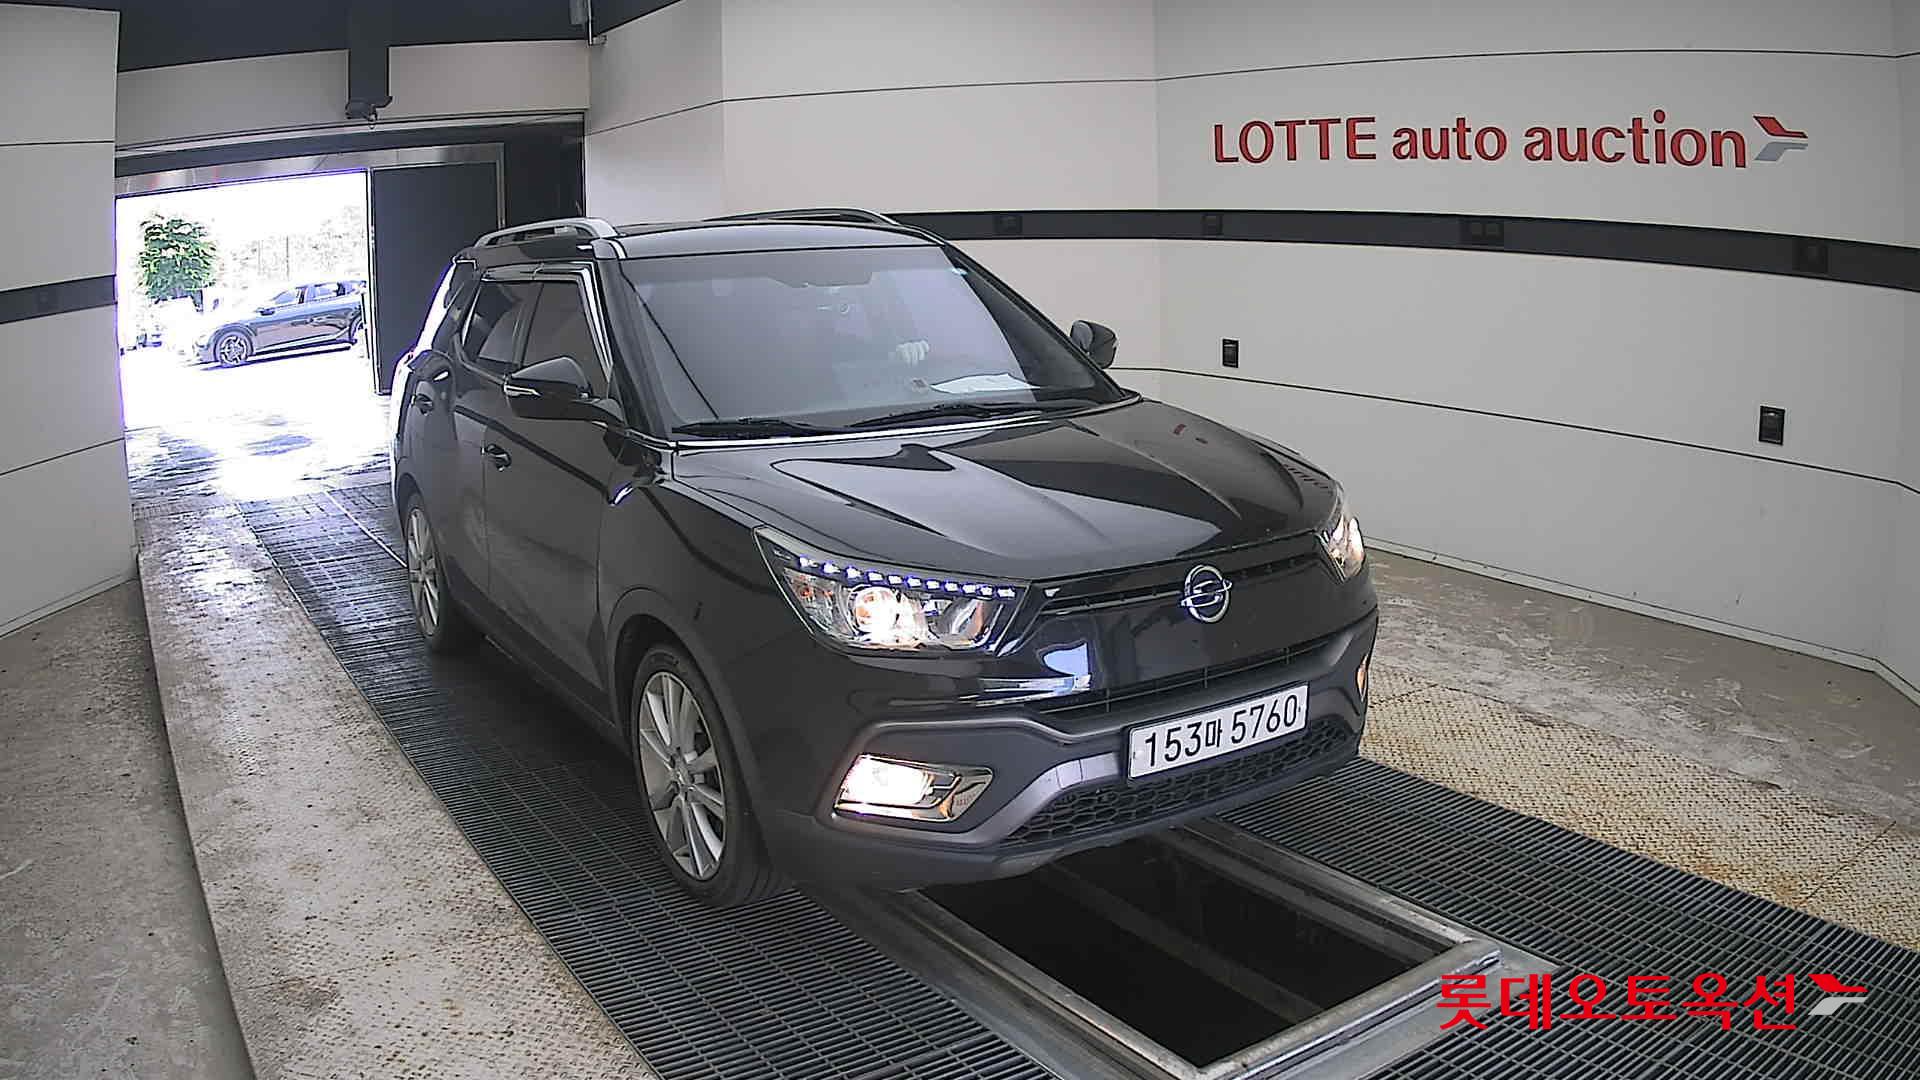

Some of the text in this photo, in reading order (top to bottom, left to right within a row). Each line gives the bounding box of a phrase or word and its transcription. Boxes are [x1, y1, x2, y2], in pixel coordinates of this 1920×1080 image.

[1213, 109, 1748, 168] LOTTE auto auction
[1144, 694, 1299, 767] 153마 5760
